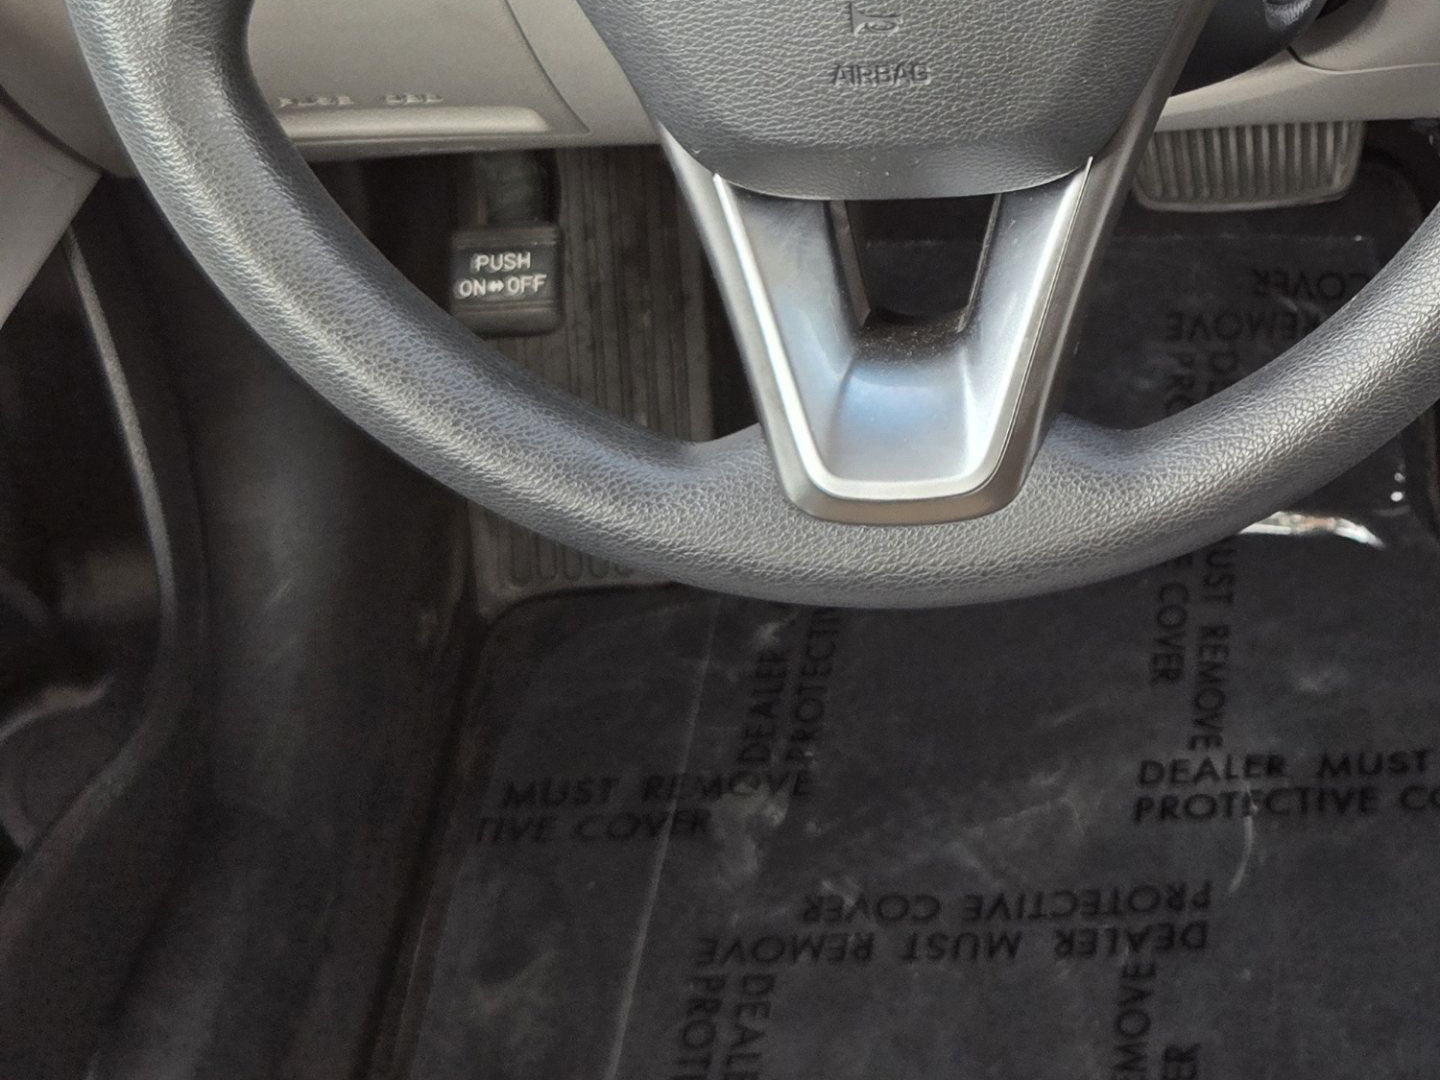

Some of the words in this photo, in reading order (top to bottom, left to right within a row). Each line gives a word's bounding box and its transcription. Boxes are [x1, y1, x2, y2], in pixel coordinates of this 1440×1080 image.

[471, 252, 531, 271] PUSH
[457, 280, 486, 299] ON
[507, 274, 547, 294] OFF
[1149, 582, 1190, 688] COVER
[1137, 752, 1287, 788] DEALER
[1316, 748, 1432, 782] MUST
[501, 774, 621, 808] MUST
[1132, 784, 1382, 822] PROTECTIVE
[573, 808, 711, 842] COVER
[802, 892, 942, 925] COVER
[961, 879, 1212, 922] PROTECTIVE
[697, 930, 874, 967] REMOVE
[900, 929, 1024, 962] MUST
[1055, 920, 1209, 960] DEALER
